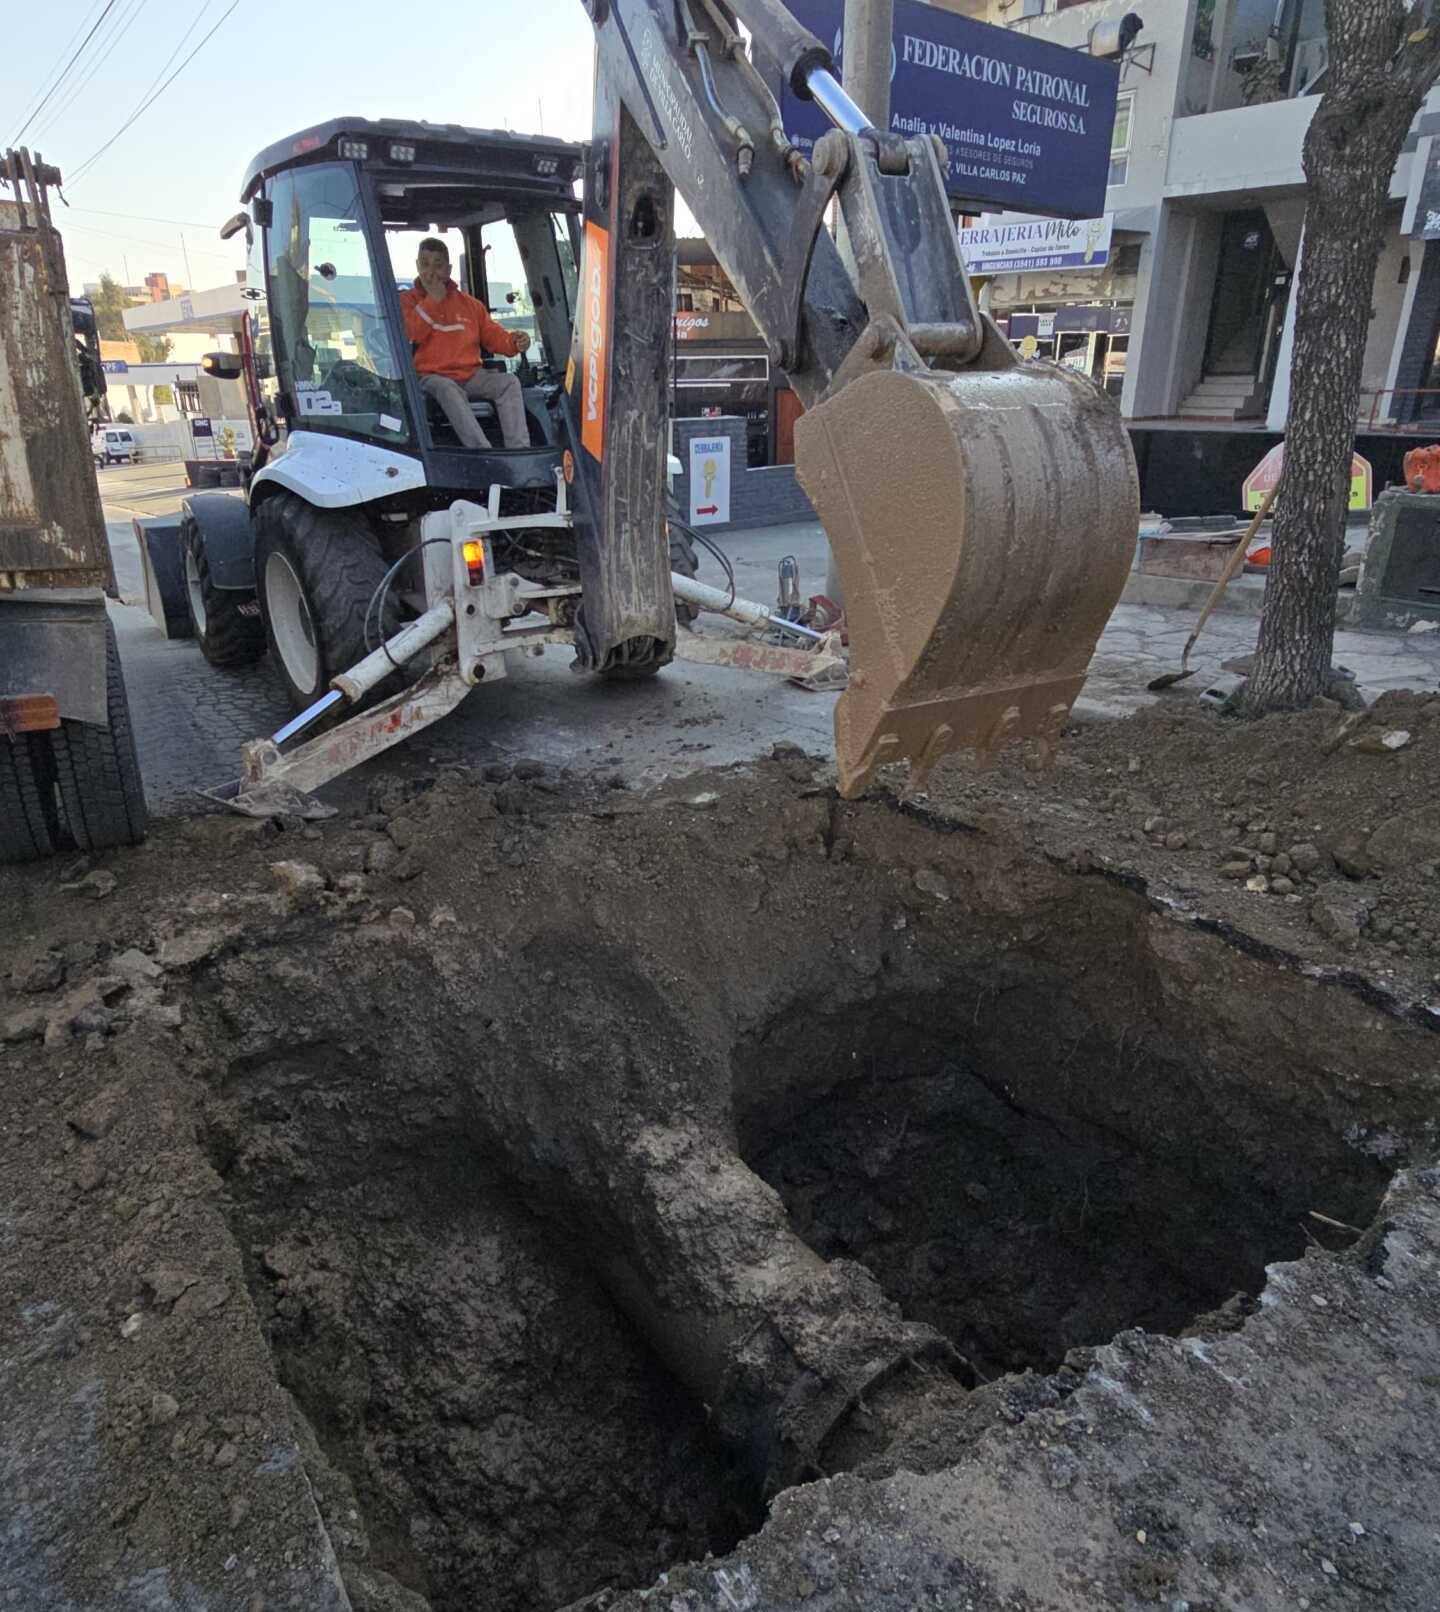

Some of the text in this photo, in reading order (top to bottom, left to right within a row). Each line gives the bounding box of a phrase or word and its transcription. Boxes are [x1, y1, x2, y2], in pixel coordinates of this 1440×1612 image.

[903, 35, 1089, 107] FEDERACION PATRONAL
[1012, 99, 1068, 130] SEGUROS
[930, 123, 937, 136] y
[939, 121, 985, 146] Valentina
[988, 132, 1016, 152] Lopez
[1018, 139, 1041, 157] Loria
[956, 161, 978, 176] VILLA
[980, 166, 1010, 182] CARLOS
[1012, 172, 1026, 185] PAZ
[959, 224, 1043, 246] ERRAJERIA
